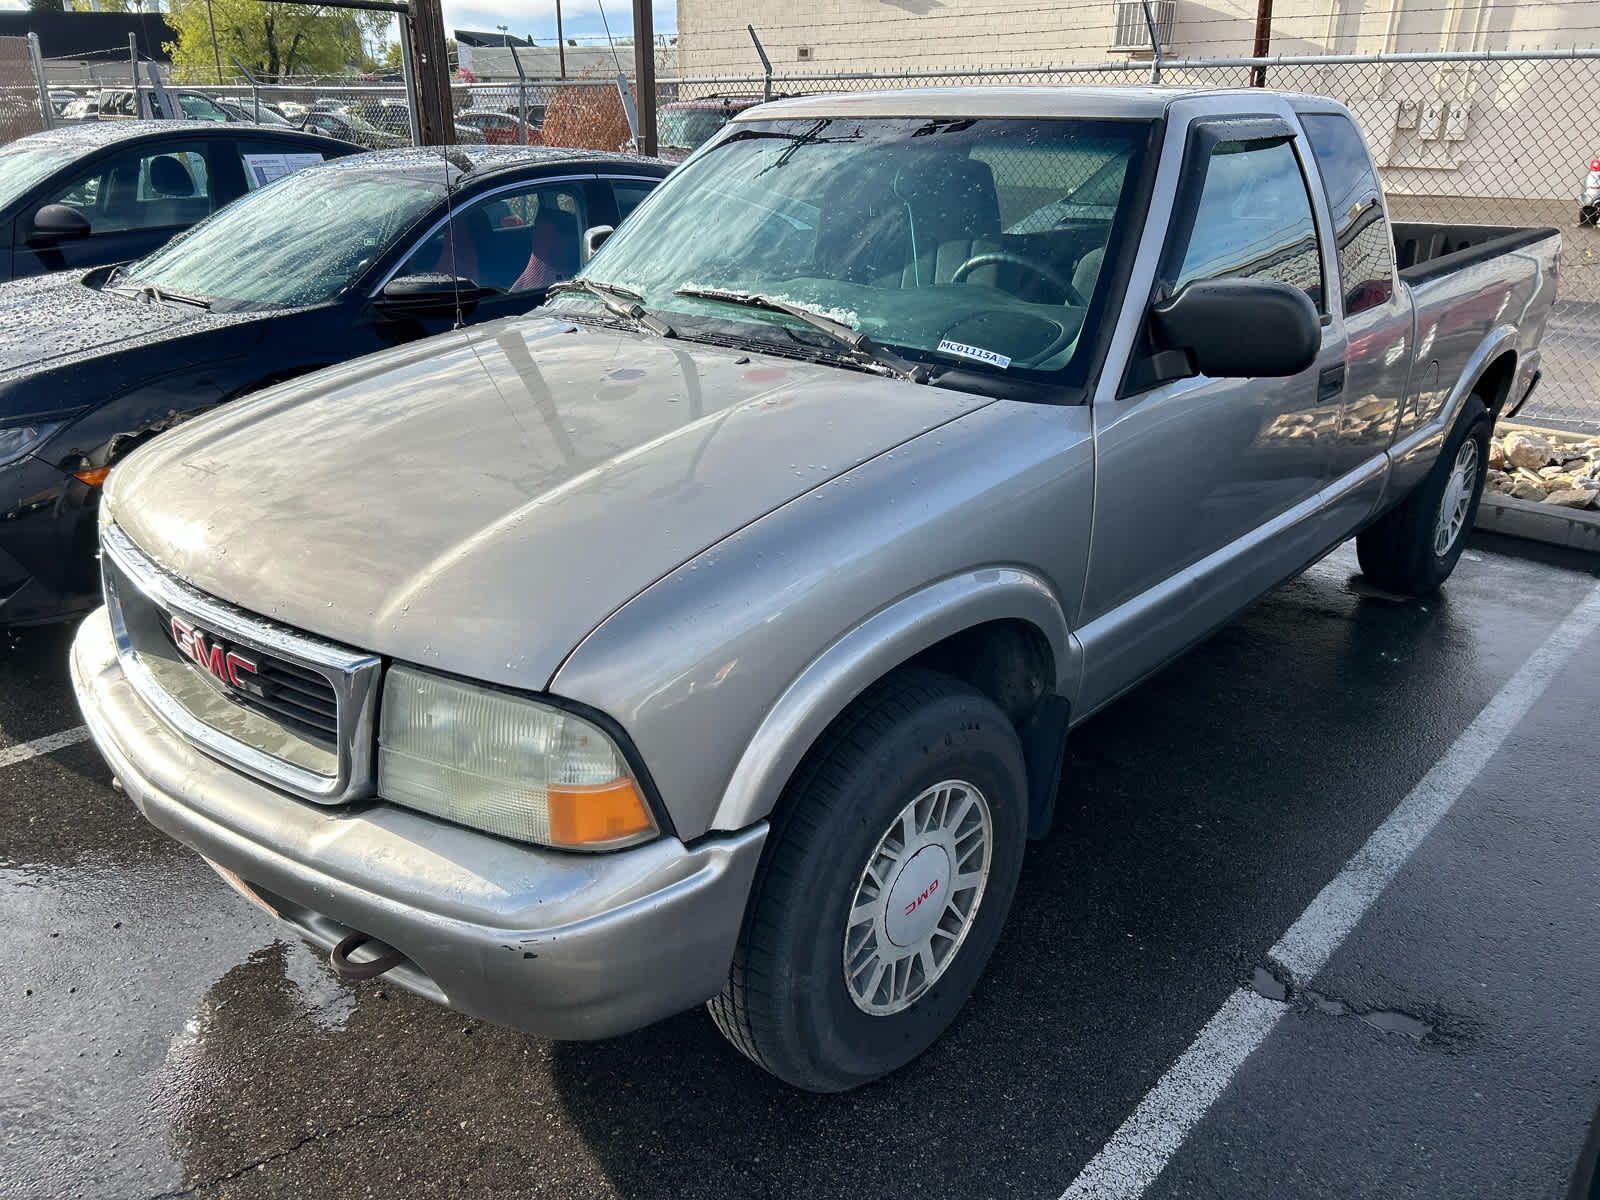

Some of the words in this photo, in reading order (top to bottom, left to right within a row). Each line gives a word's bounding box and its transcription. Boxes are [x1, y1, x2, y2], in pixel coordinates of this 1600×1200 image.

[940, 341, 997, 362] MC01115A
[171, 616, 258, 690] GMC
[904, 879, 939, 917] GMC
